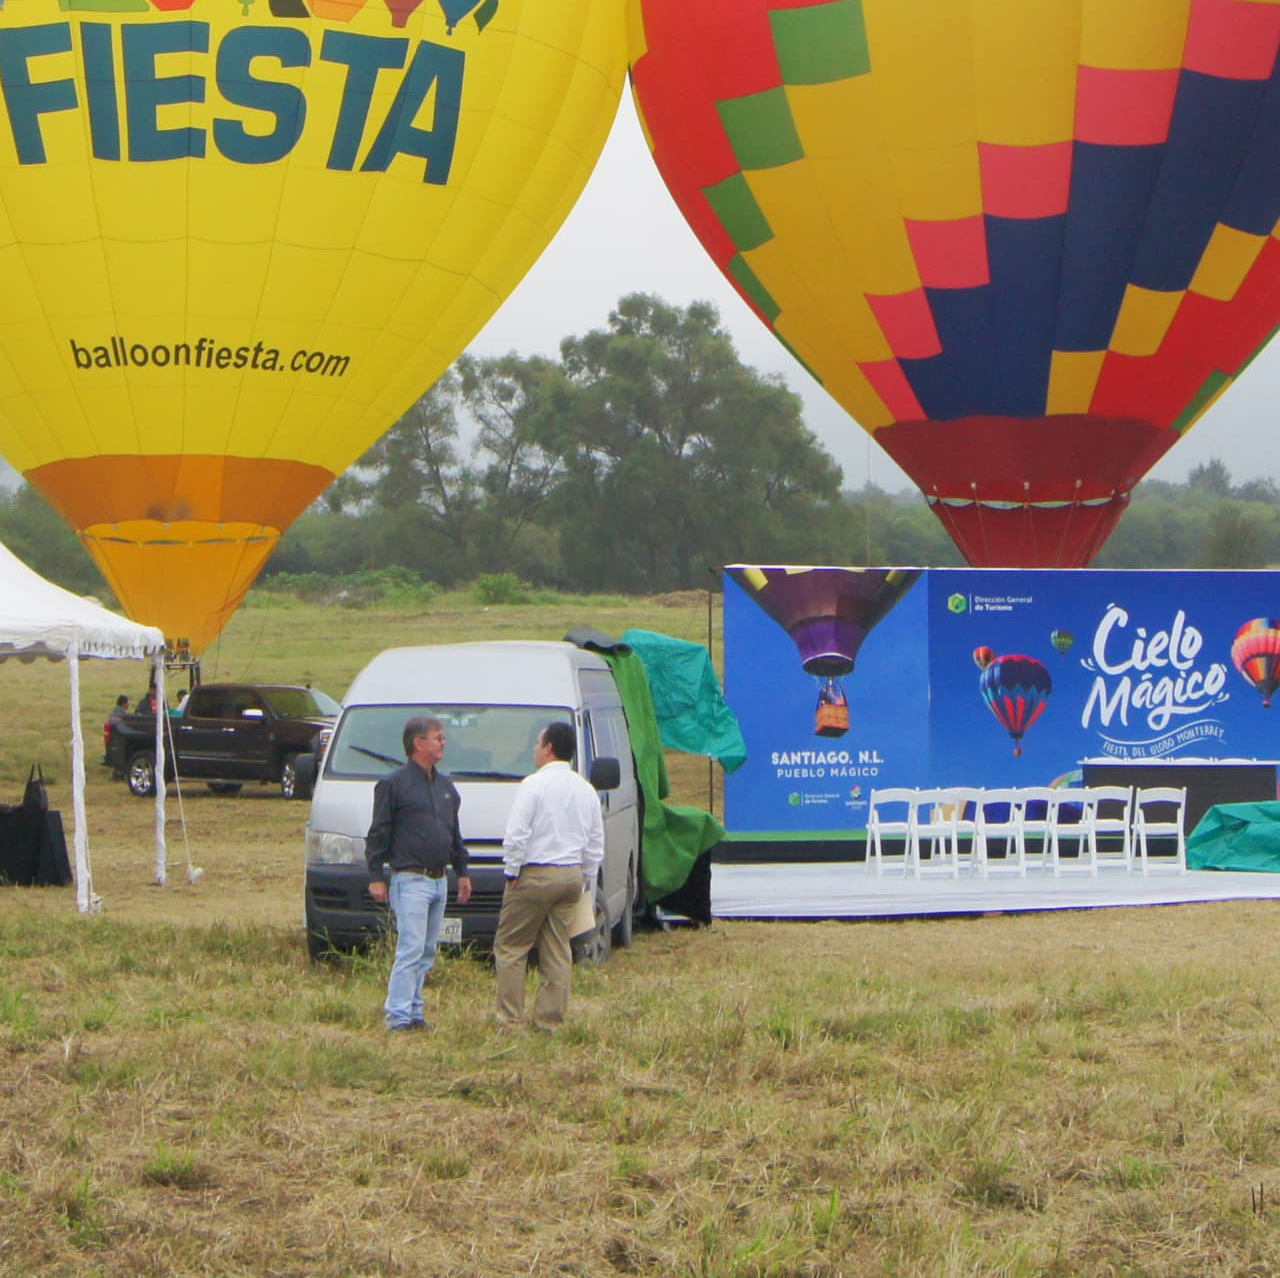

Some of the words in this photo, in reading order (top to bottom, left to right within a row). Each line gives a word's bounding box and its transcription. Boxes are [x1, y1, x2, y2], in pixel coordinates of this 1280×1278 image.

[69, 336, 351, 377] balloonfiesta.com
[1093, 606, 1203, 675] Cielo
[1081, 663, 1226, 731] Mágico
[859, 750, 885, 763] N.L.
[1103, 741, 1128, 757] FIESTA
[1132, 747, 1146, 758] DEL
[1150, 737, 1175, 755] GLOBO
[1176, 724, 1224, 743] MONTERREY
[777, 768, 825, 778] PUEBLO
[830, 766, 879, 777] MÁGICO
